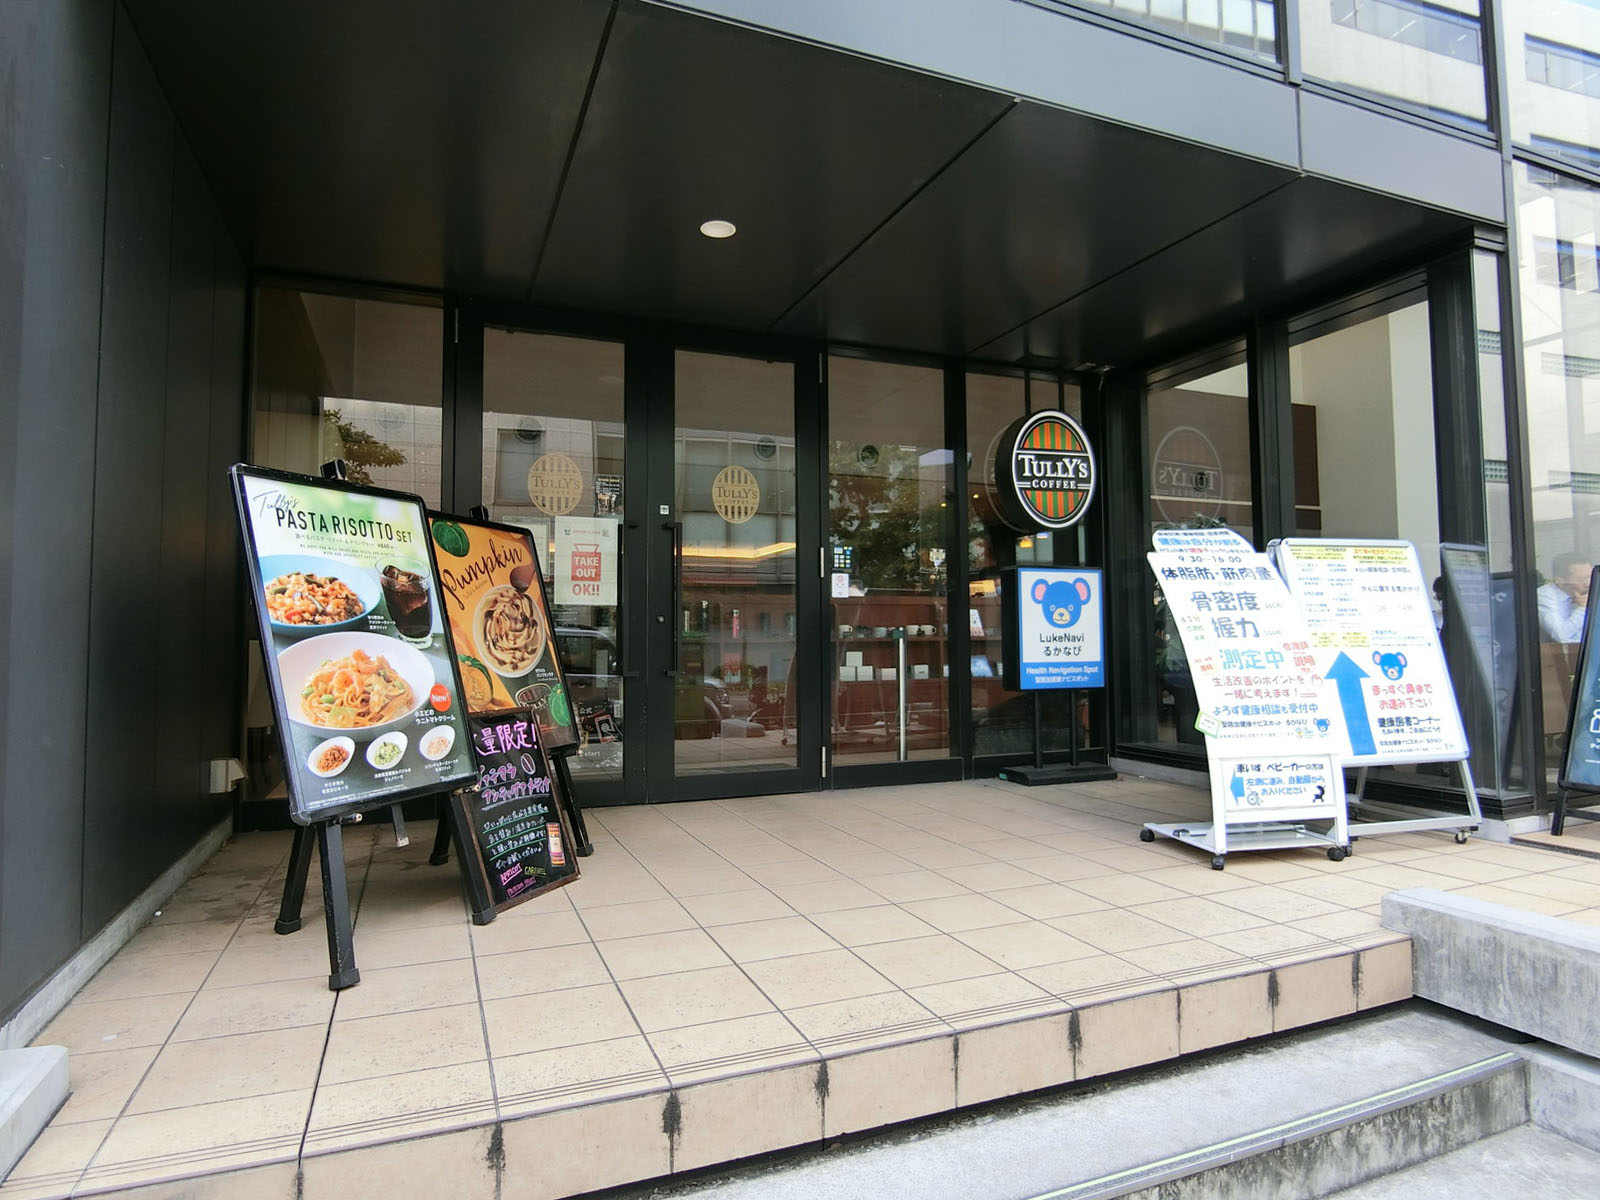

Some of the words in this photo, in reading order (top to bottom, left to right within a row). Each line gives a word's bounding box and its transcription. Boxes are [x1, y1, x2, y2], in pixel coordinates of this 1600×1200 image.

[1018, 455, 1088, 478] TULLY'S
[531, 475, 580, 489] TULLY'S
[1032, 479, 1077, 489] COFFEE
[715, 486, 757, 499] TULLY'S
[276, 508, 329, 534] PASTA
[332, 515, 393, 541] RISOTTO
[396, 530, 413, 544] SET
[574, 556, 599, 567] TAKE
[576, 568, 597, 578] OUT
[1161, 566, 1275, 580] 体脂肪・筋肉量
[572, 583, 600, 596] OK!!
[1191, 590, 1260, 611] 骨密度
[1211, 617, 1260, 638] 握力
[1040, 632, 1085, 643] LukeNavi
[1043, 646, 1081, 656] るかなび
[1219, 648, 1285, 670] 測定中
[1026, 666, 1047, 675] Health
[1048, 666, 1082, 675] Navigation
[1083, 665, 1098, 674] Spot
[1371, 683, 1432, 696] まっすぐ奥まで
[473, 721, 537, 756] 量限定!
